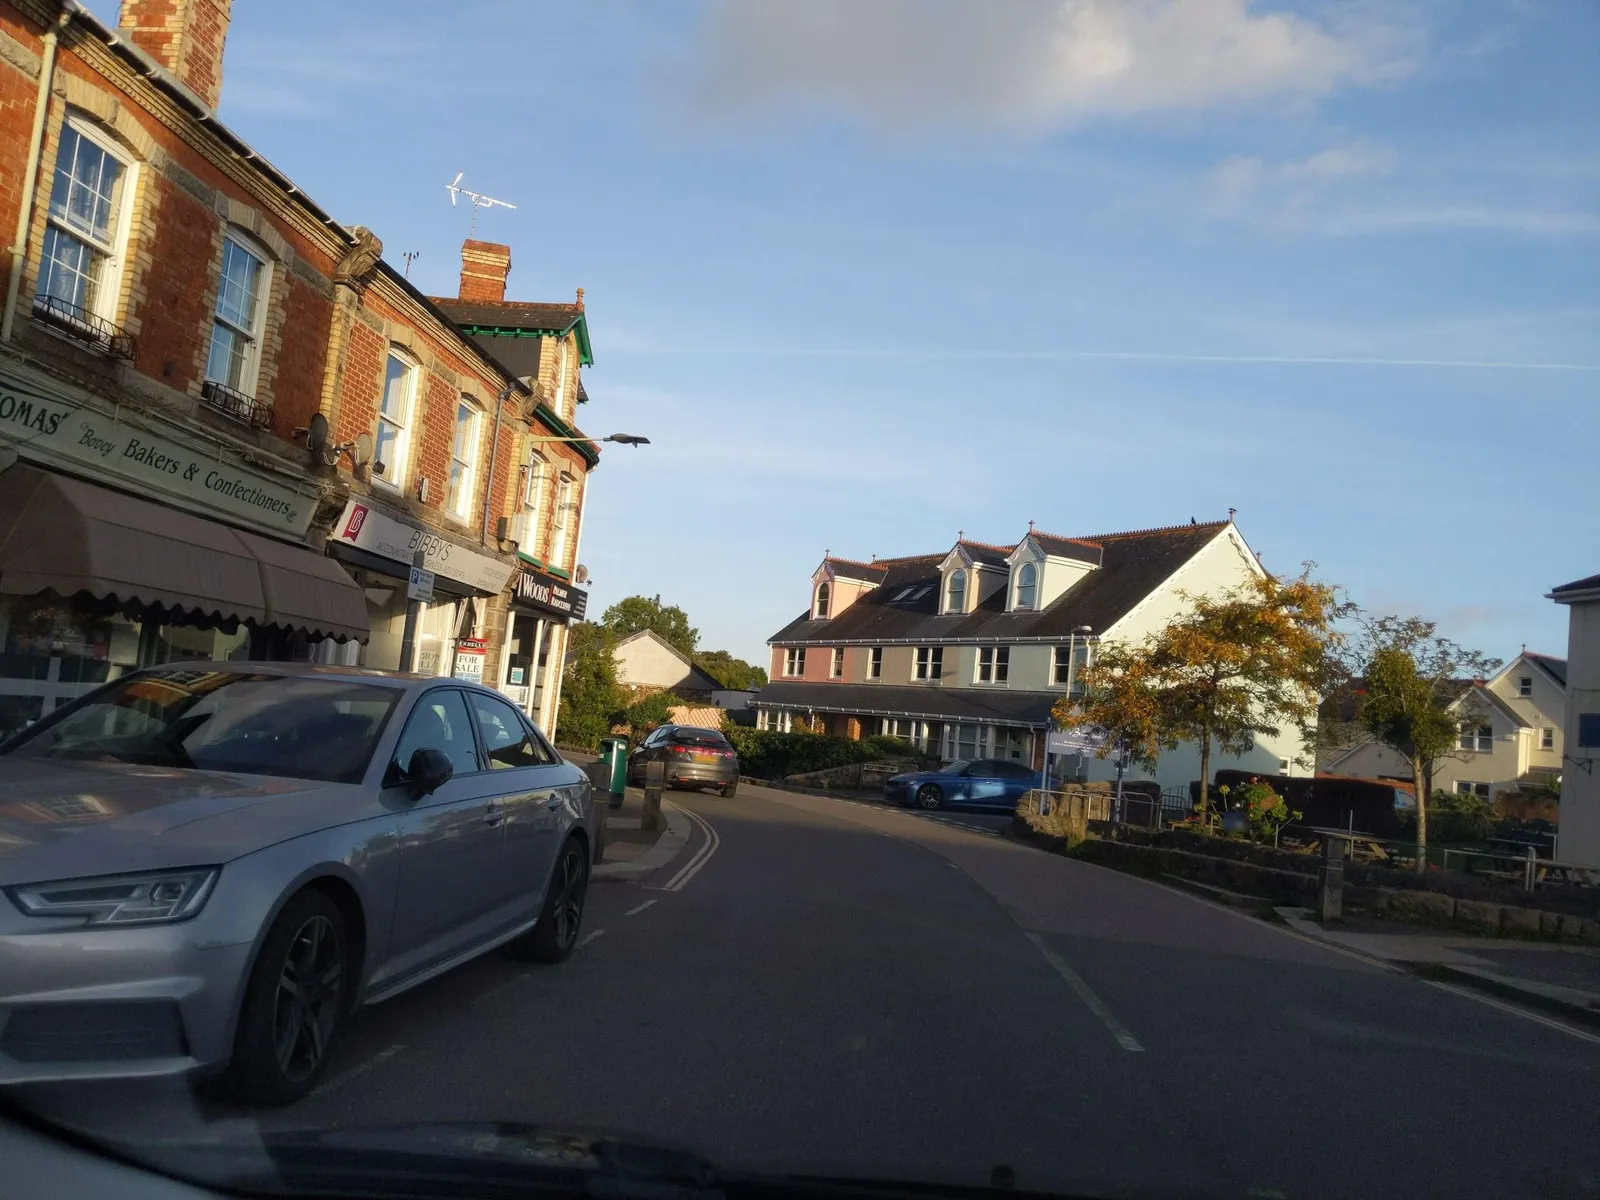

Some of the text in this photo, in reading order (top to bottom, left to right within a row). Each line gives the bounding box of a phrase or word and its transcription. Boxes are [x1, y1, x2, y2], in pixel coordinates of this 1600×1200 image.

[0, 395, 70, 435] OMAS'
[123, 437, 181, 474] Bakers
[183, 463, 200, 482] &
[204, 470, 292, 515] Confectioners
[408, 530, 453, 561] BIBBYS
[523, 572, 550, 603] WOODS
[456, 664, 480, 673] SALE
[459, 655, 478, 664] FOR
